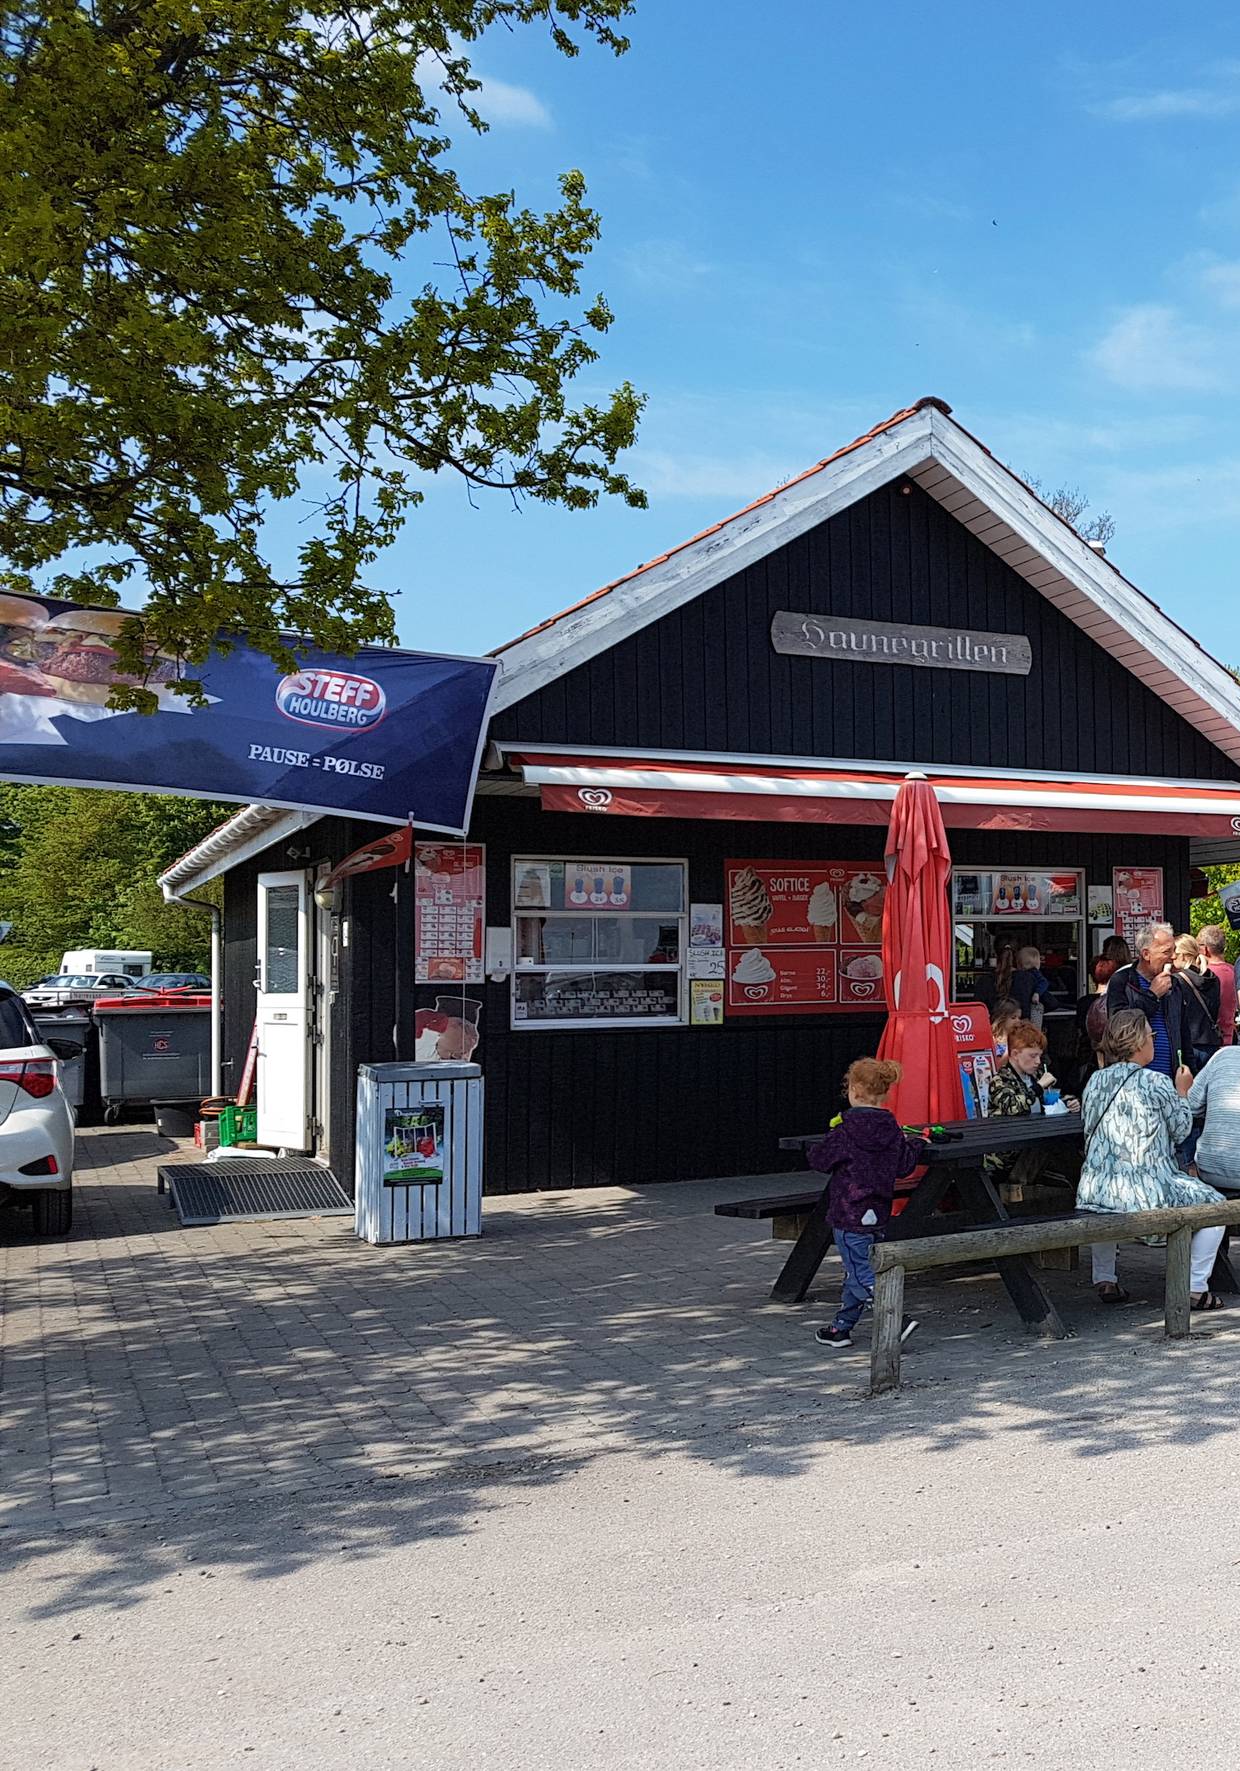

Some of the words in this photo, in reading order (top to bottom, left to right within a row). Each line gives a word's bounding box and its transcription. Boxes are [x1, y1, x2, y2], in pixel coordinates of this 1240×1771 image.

[298, 671, 374, 707] STEFF
[289, 695, 368, 726] HOULBERG
[248, 743, 309, 768] PAUSE
[322, 755, 385, 781] PØLSE
[769, 878, 810, 892] SOFTICE
